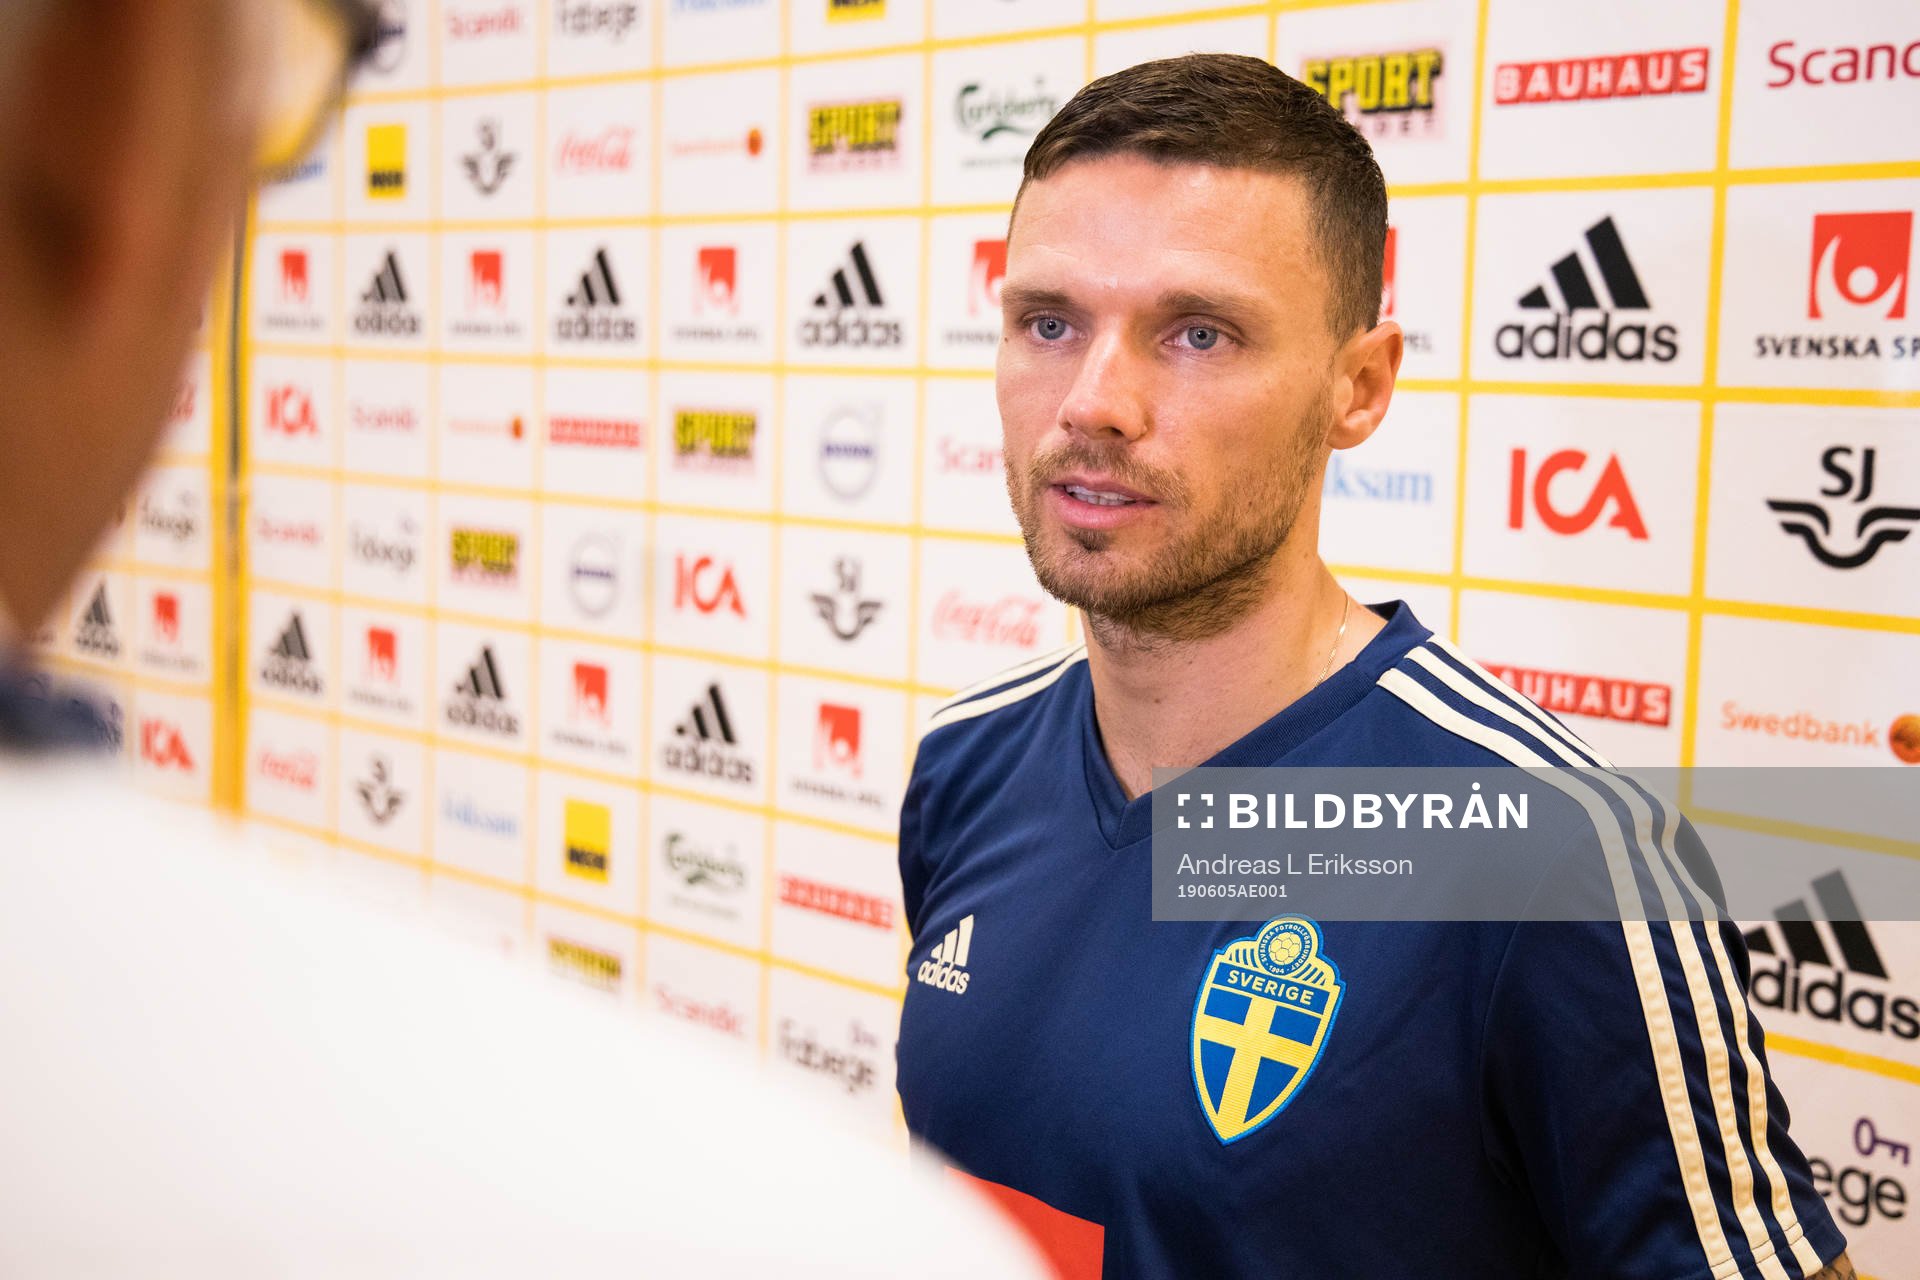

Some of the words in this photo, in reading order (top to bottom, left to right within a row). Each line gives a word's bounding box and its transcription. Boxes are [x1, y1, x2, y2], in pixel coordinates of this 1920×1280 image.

[1305, 49, 1442, 114] SPORT
[1496, 51, 1705, 100] BAUHAUS
[1495, 308, 1680, 363] adidas
[1756, 335, 1881, 359] SVENSKA
[1893, 335, 1920, 359] SP
[1509, 448, 1650, 540] ICA
[1820, 446, 1877, 502] SJ
[674, 554, 747, 619] ICA
[1500, 668, 1668, 724] AUHAUS
[1721, 700, 1880, 748] Swedbank
[917, 957, 970, 995] adidas
[1227, 969, 1314, 1006] SVERIGE
[1750, 958, 1920, 1041] didas
[1808, 1156, 1907, 1227] ege
